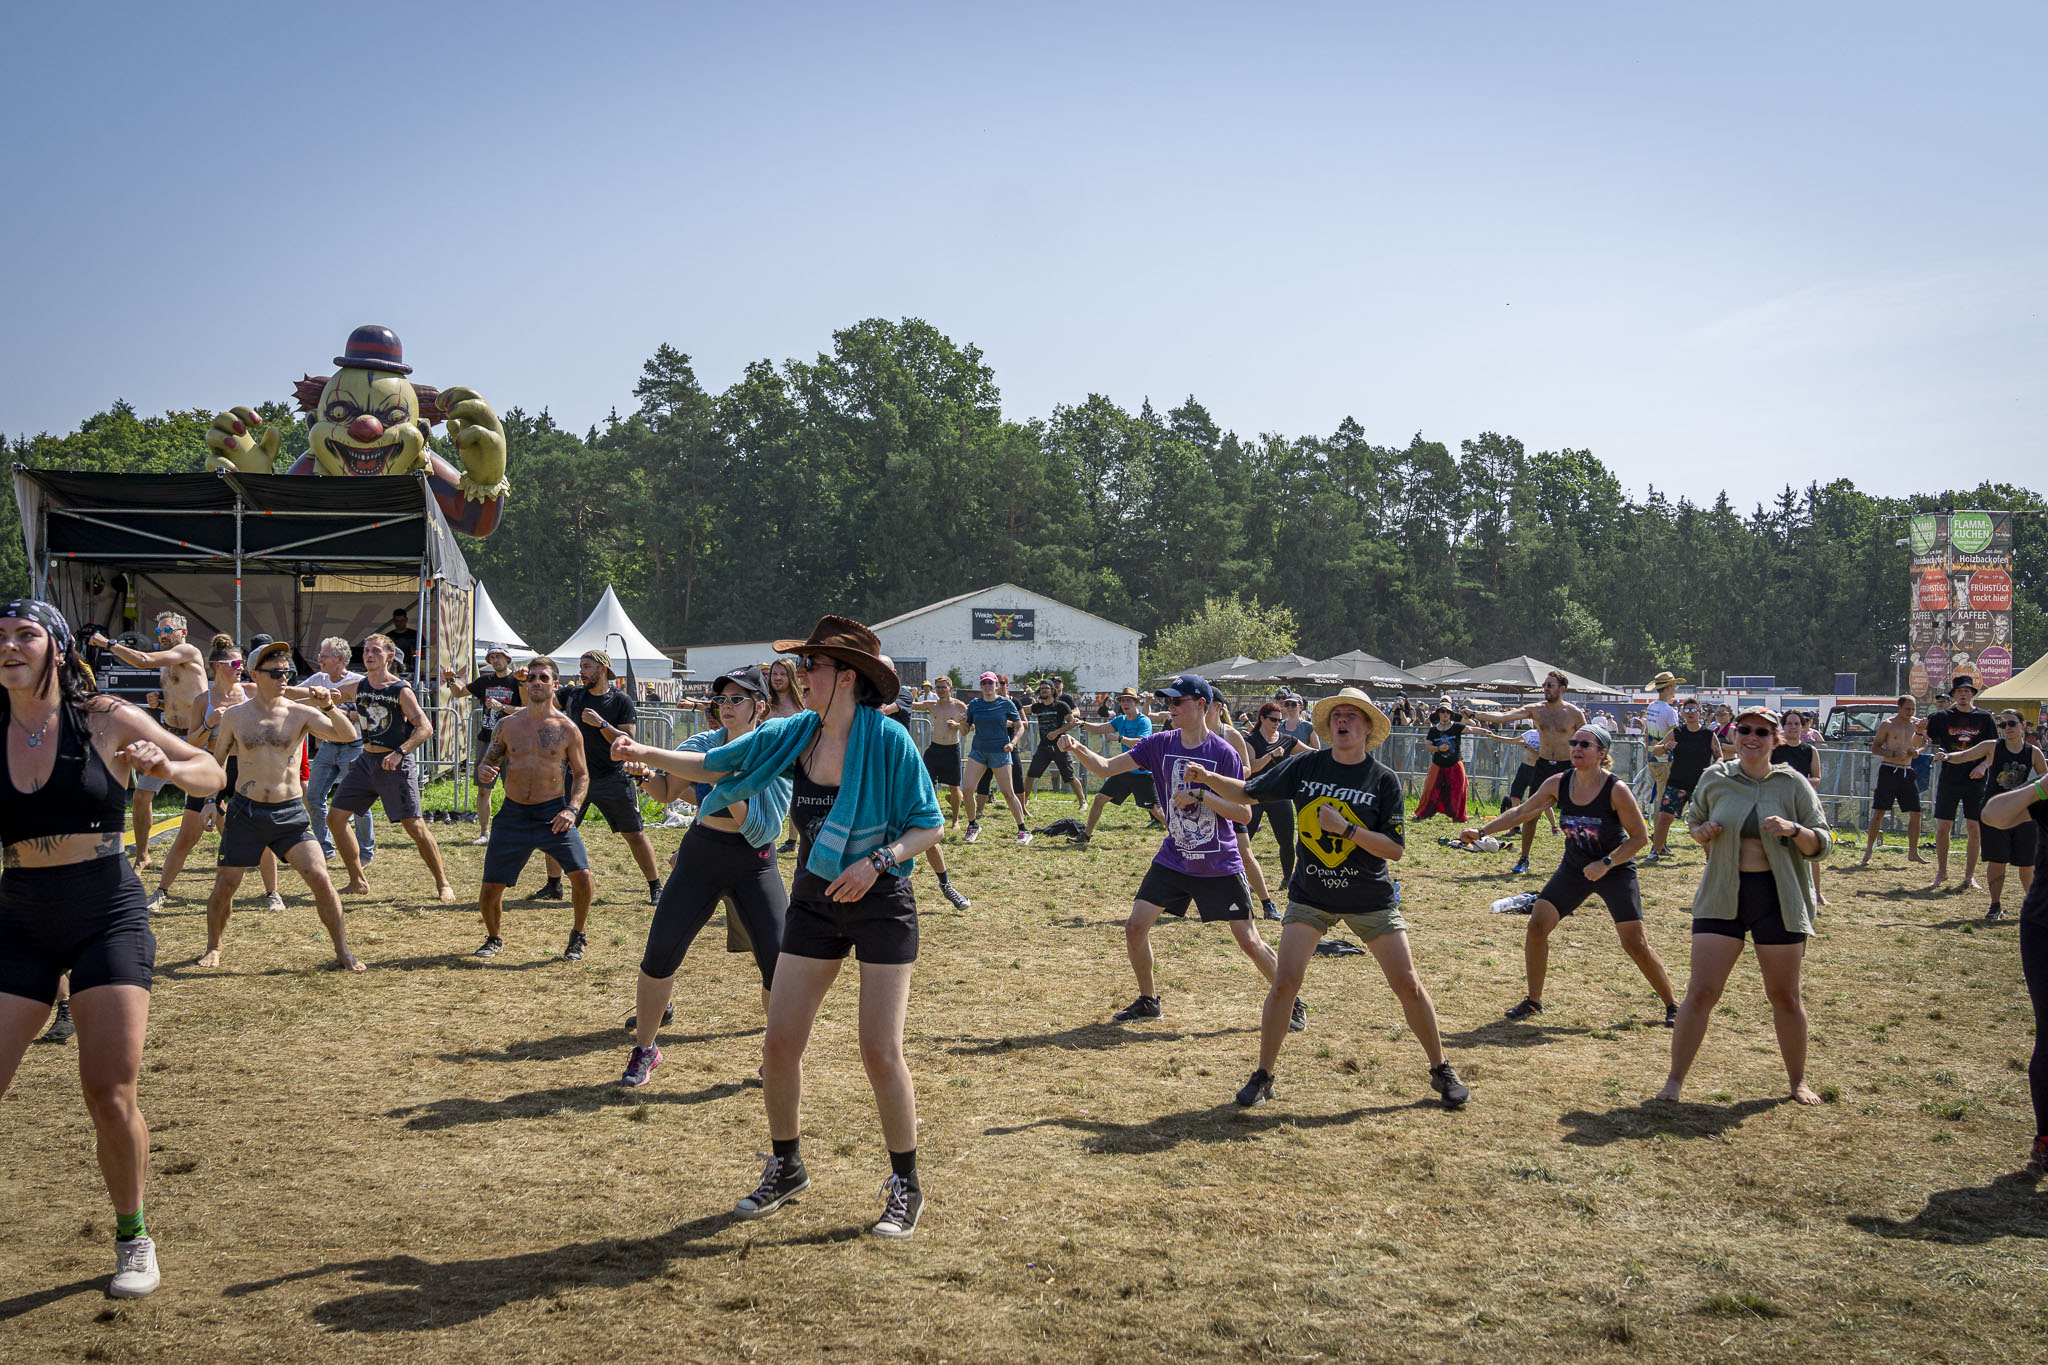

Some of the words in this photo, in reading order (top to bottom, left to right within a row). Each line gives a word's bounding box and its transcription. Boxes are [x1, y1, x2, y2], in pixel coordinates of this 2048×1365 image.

[1954, 520, 1989, 529] FLAMM-
[1954, 529, 1990, 538] KUCHEN
[1959, 555, 2009, 564] Holzbackofen
[1970, 582, 2010, 592] FRÜHSTÜCK
[1972, 594, 1992, 602] rockt
[1993, 594, 2009, 602] hier!
[1912, 611, 1931, 620] KAFFEE
[1958, 611, 1987, 620] KAFFEE
[1974, 621, 1990, 630] hot!
[1980, 666, 2009, 675] beflügeln!
[796, 795, 835, 807] paradi
[1306, 864, 1338, 877] Open
[1340, 866, 1360, 877] Air
[1321, 878, 1349, 889] 1996
